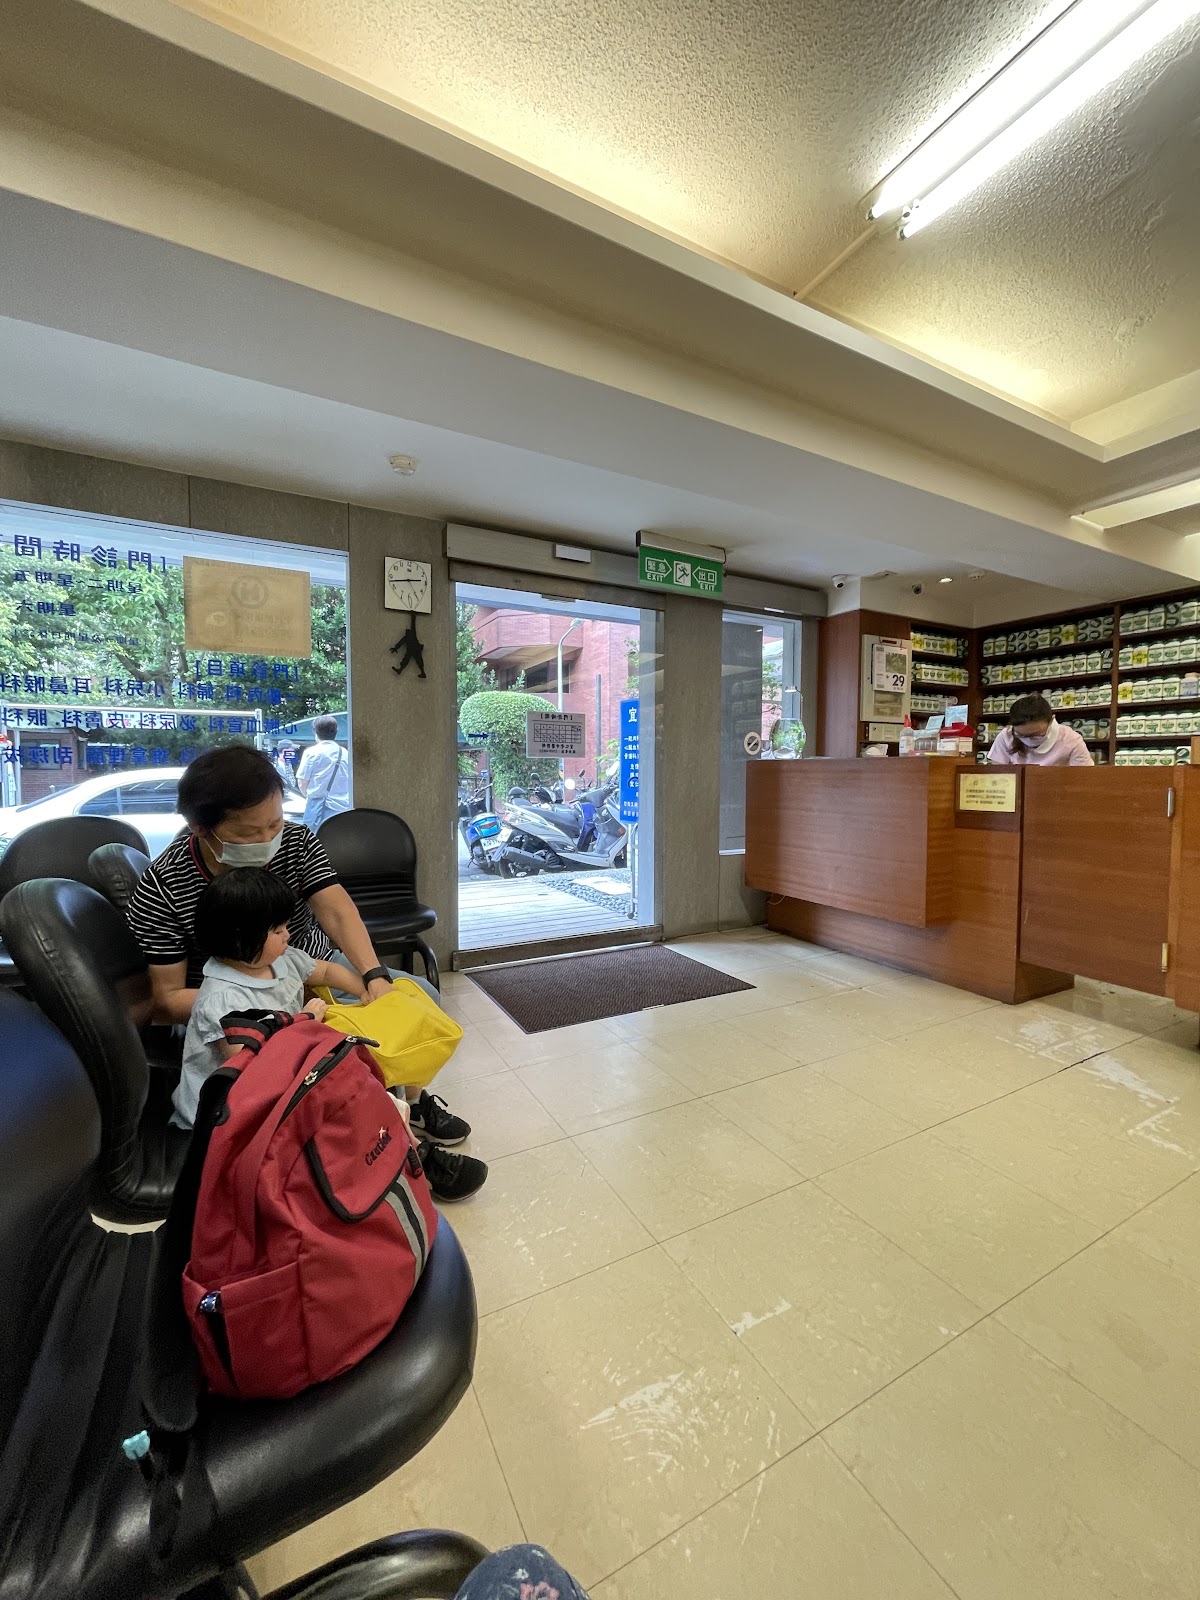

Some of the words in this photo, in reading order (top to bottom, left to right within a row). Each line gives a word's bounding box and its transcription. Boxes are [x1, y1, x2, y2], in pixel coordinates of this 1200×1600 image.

[647, 560, 666, 573] 緊急
[647, 573, 664, 583] EXIT
[698, 571, 715, 582] 出口
[700, 584, 716, 592] EXIT
[892, 674, 905, 687] 29
[628, 707, 638, 723] 宜
